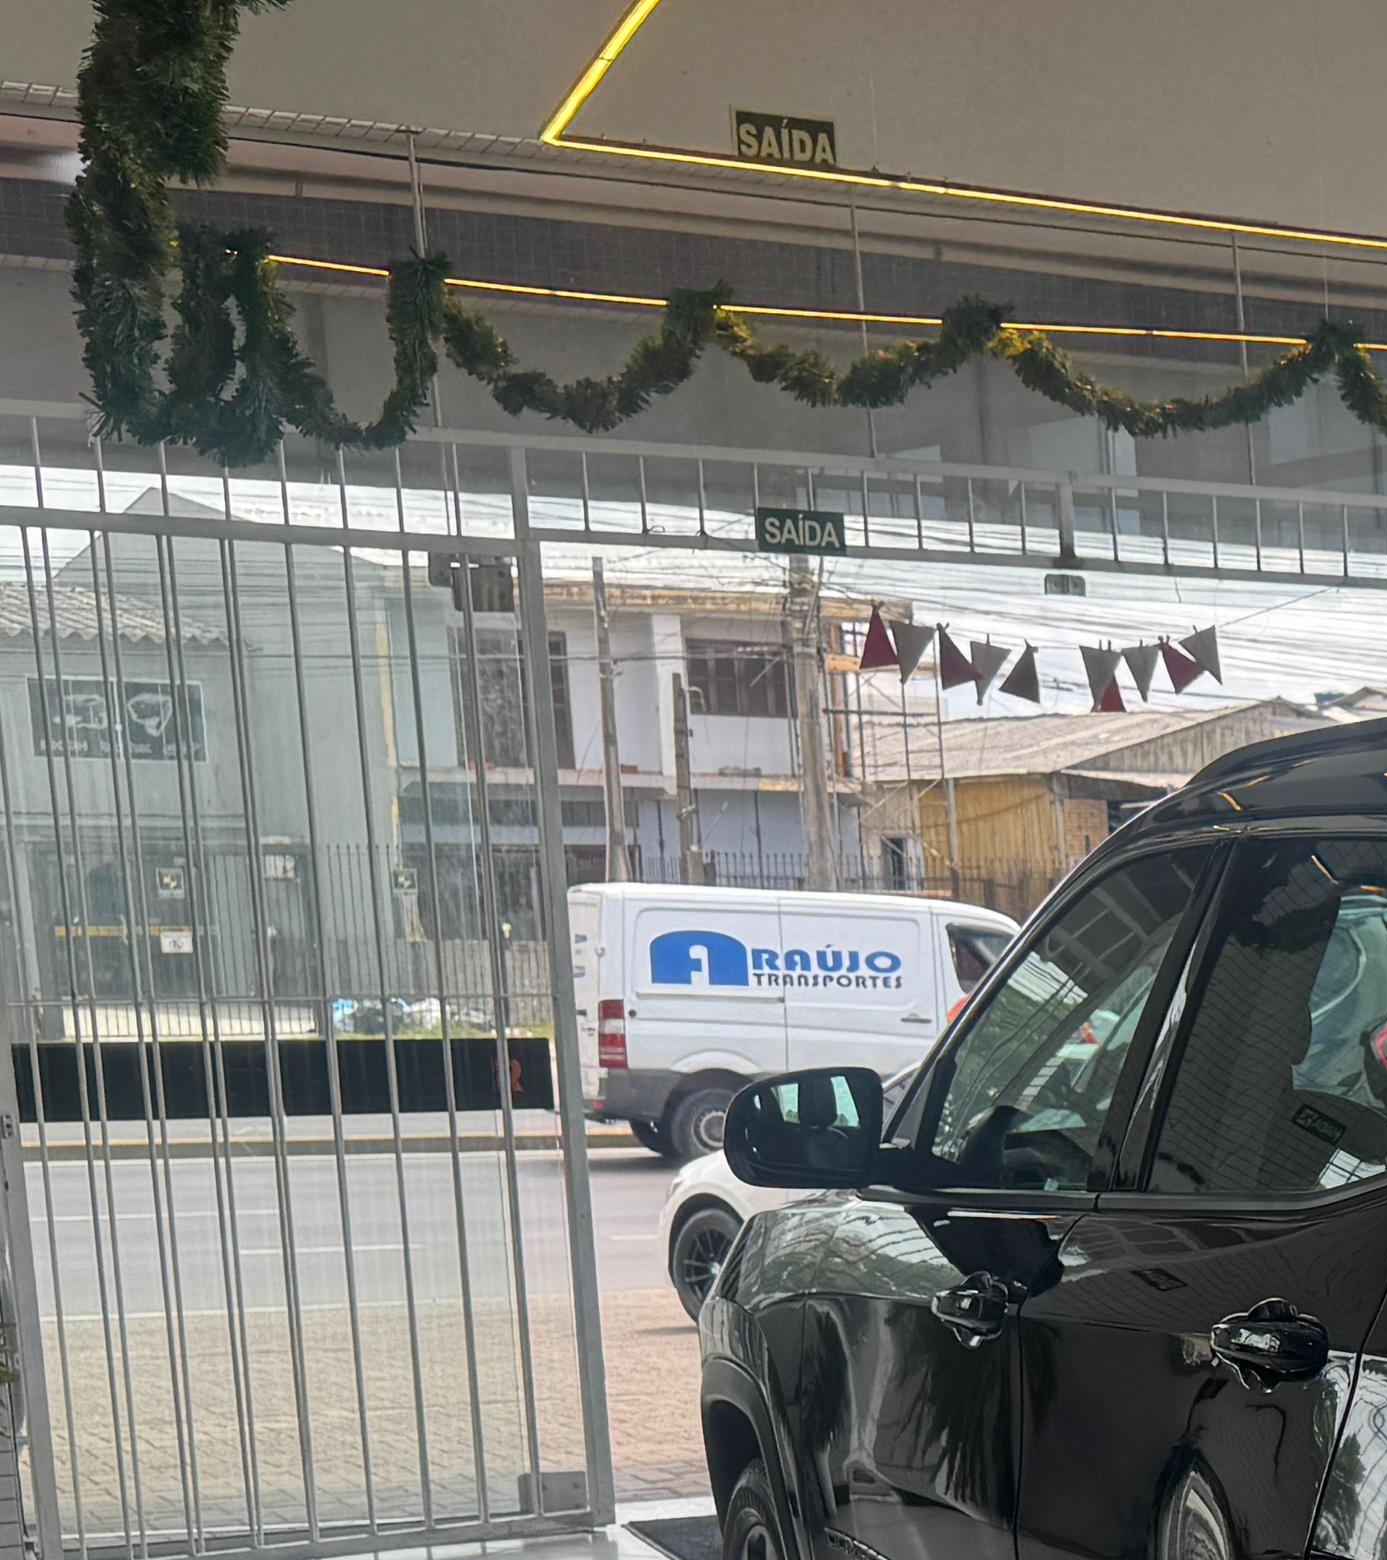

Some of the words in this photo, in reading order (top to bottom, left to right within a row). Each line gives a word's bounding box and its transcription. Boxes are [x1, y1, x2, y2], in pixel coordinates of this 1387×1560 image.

[738, 117, 836, 167] SAÍDA
[764, 512, 841, 549] SAÍDA
[649, 930, 902, 987] ARAÚJO
[752, 972, 903, 990] TRANSPORTES
